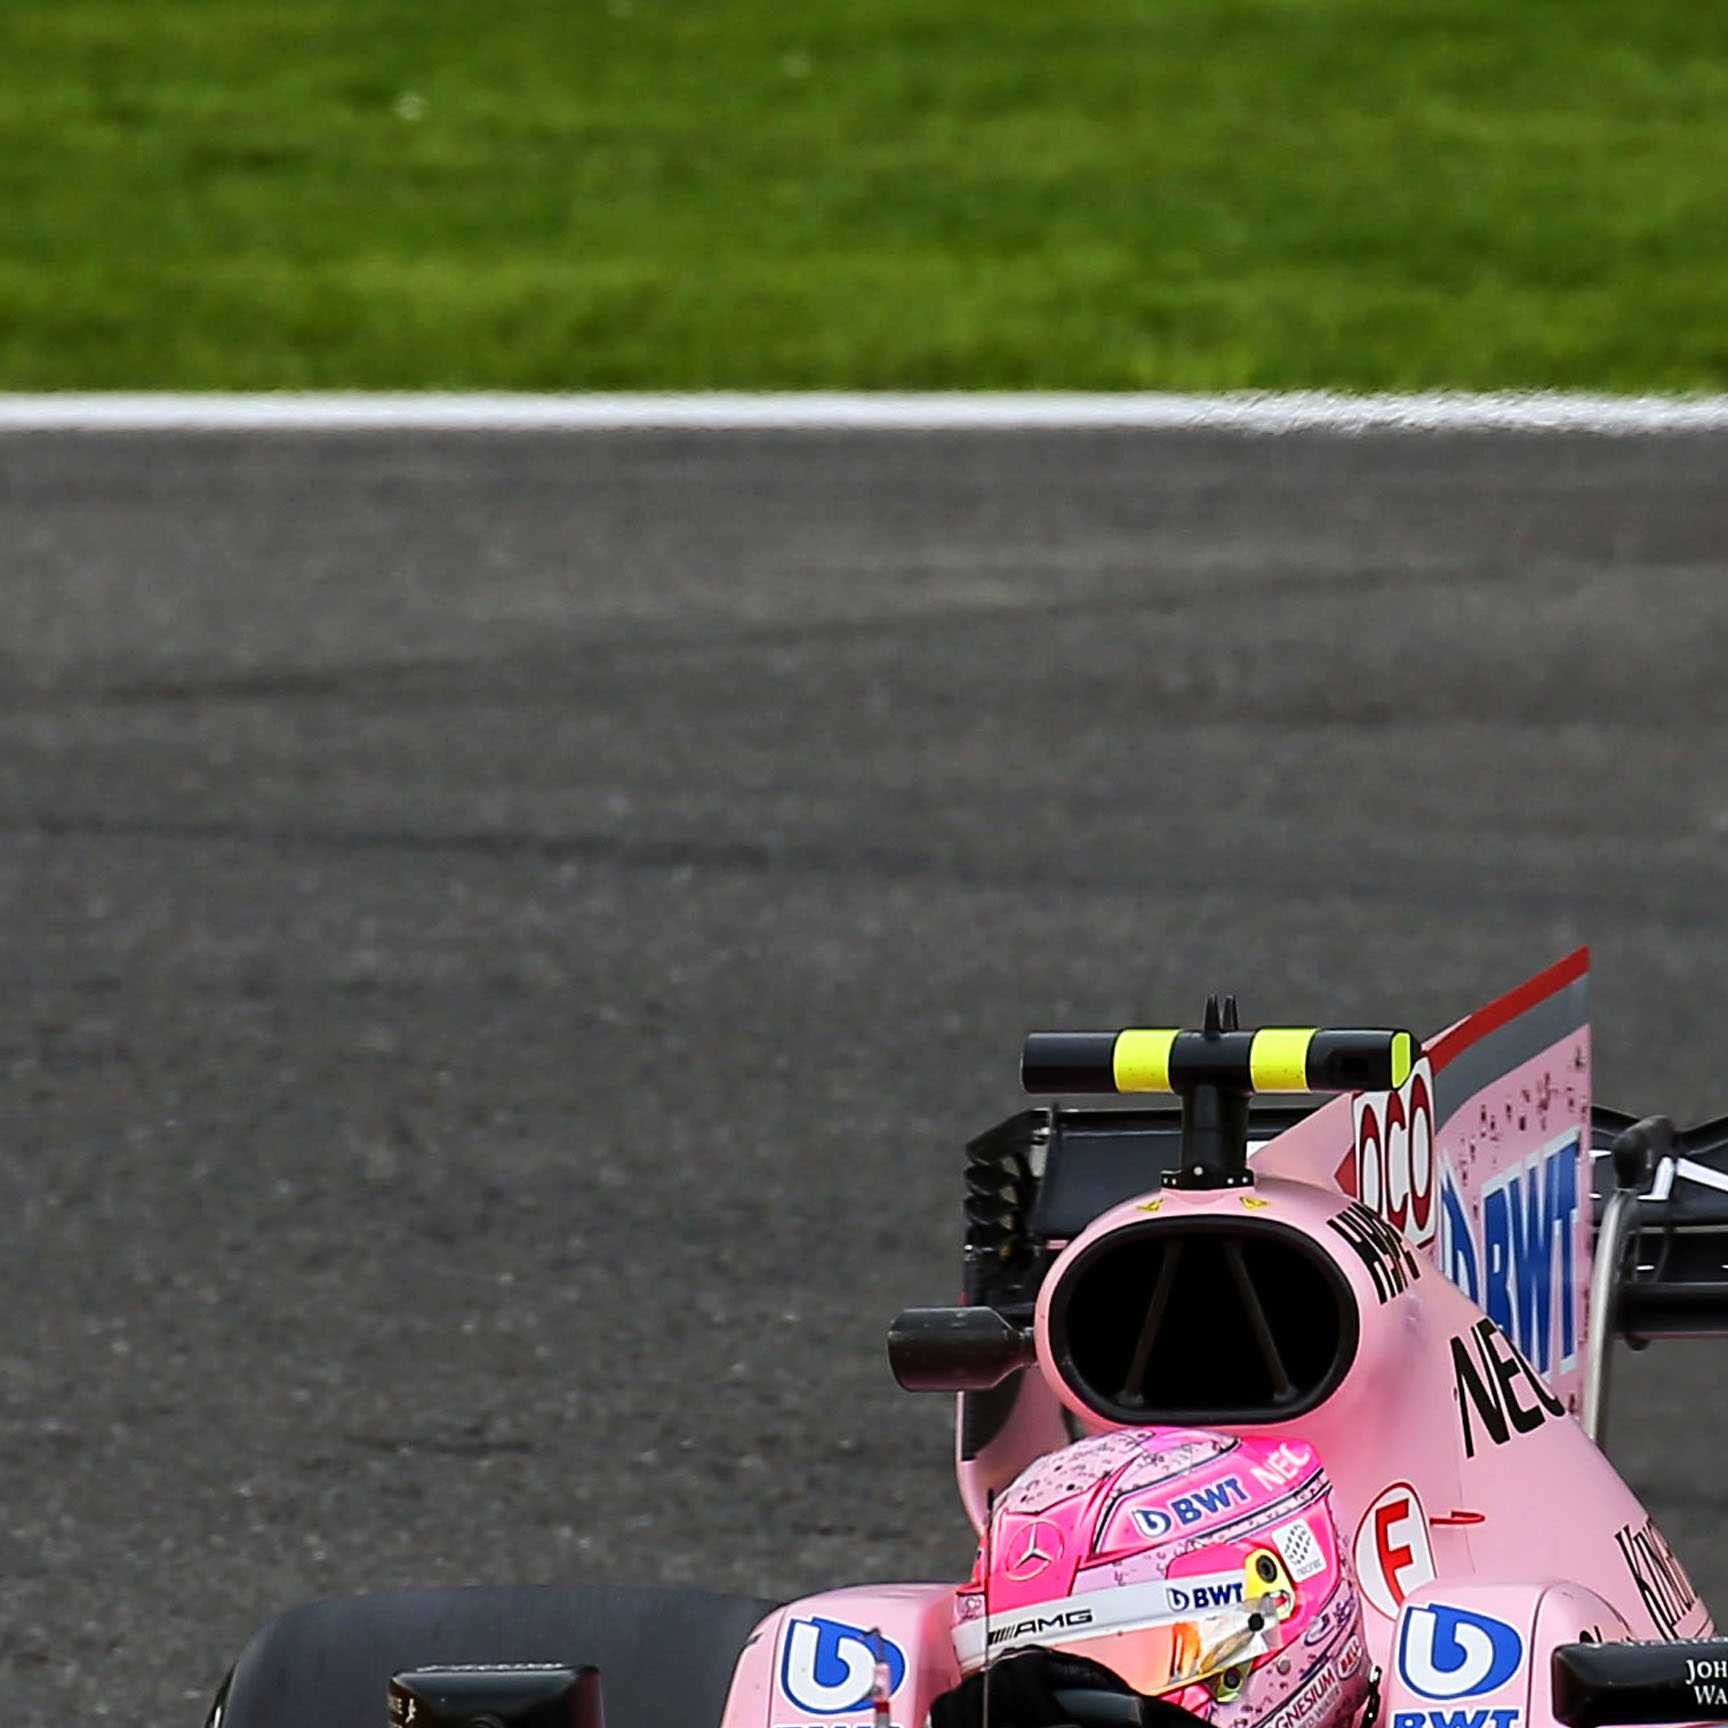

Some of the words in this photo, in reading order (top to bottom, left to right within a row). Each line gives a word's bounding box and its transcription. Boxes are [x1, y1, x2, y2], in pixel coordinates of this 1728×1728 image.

[1483, 1139, 1579, 1371] BWT
[1251, 1441, 1311, 1492] NEC
[1171, 1477, 1249, 1526] BWT
[1192, 1583, 1243, 1608] BWT
[1013, 1608, 1093, 1638] AMG
